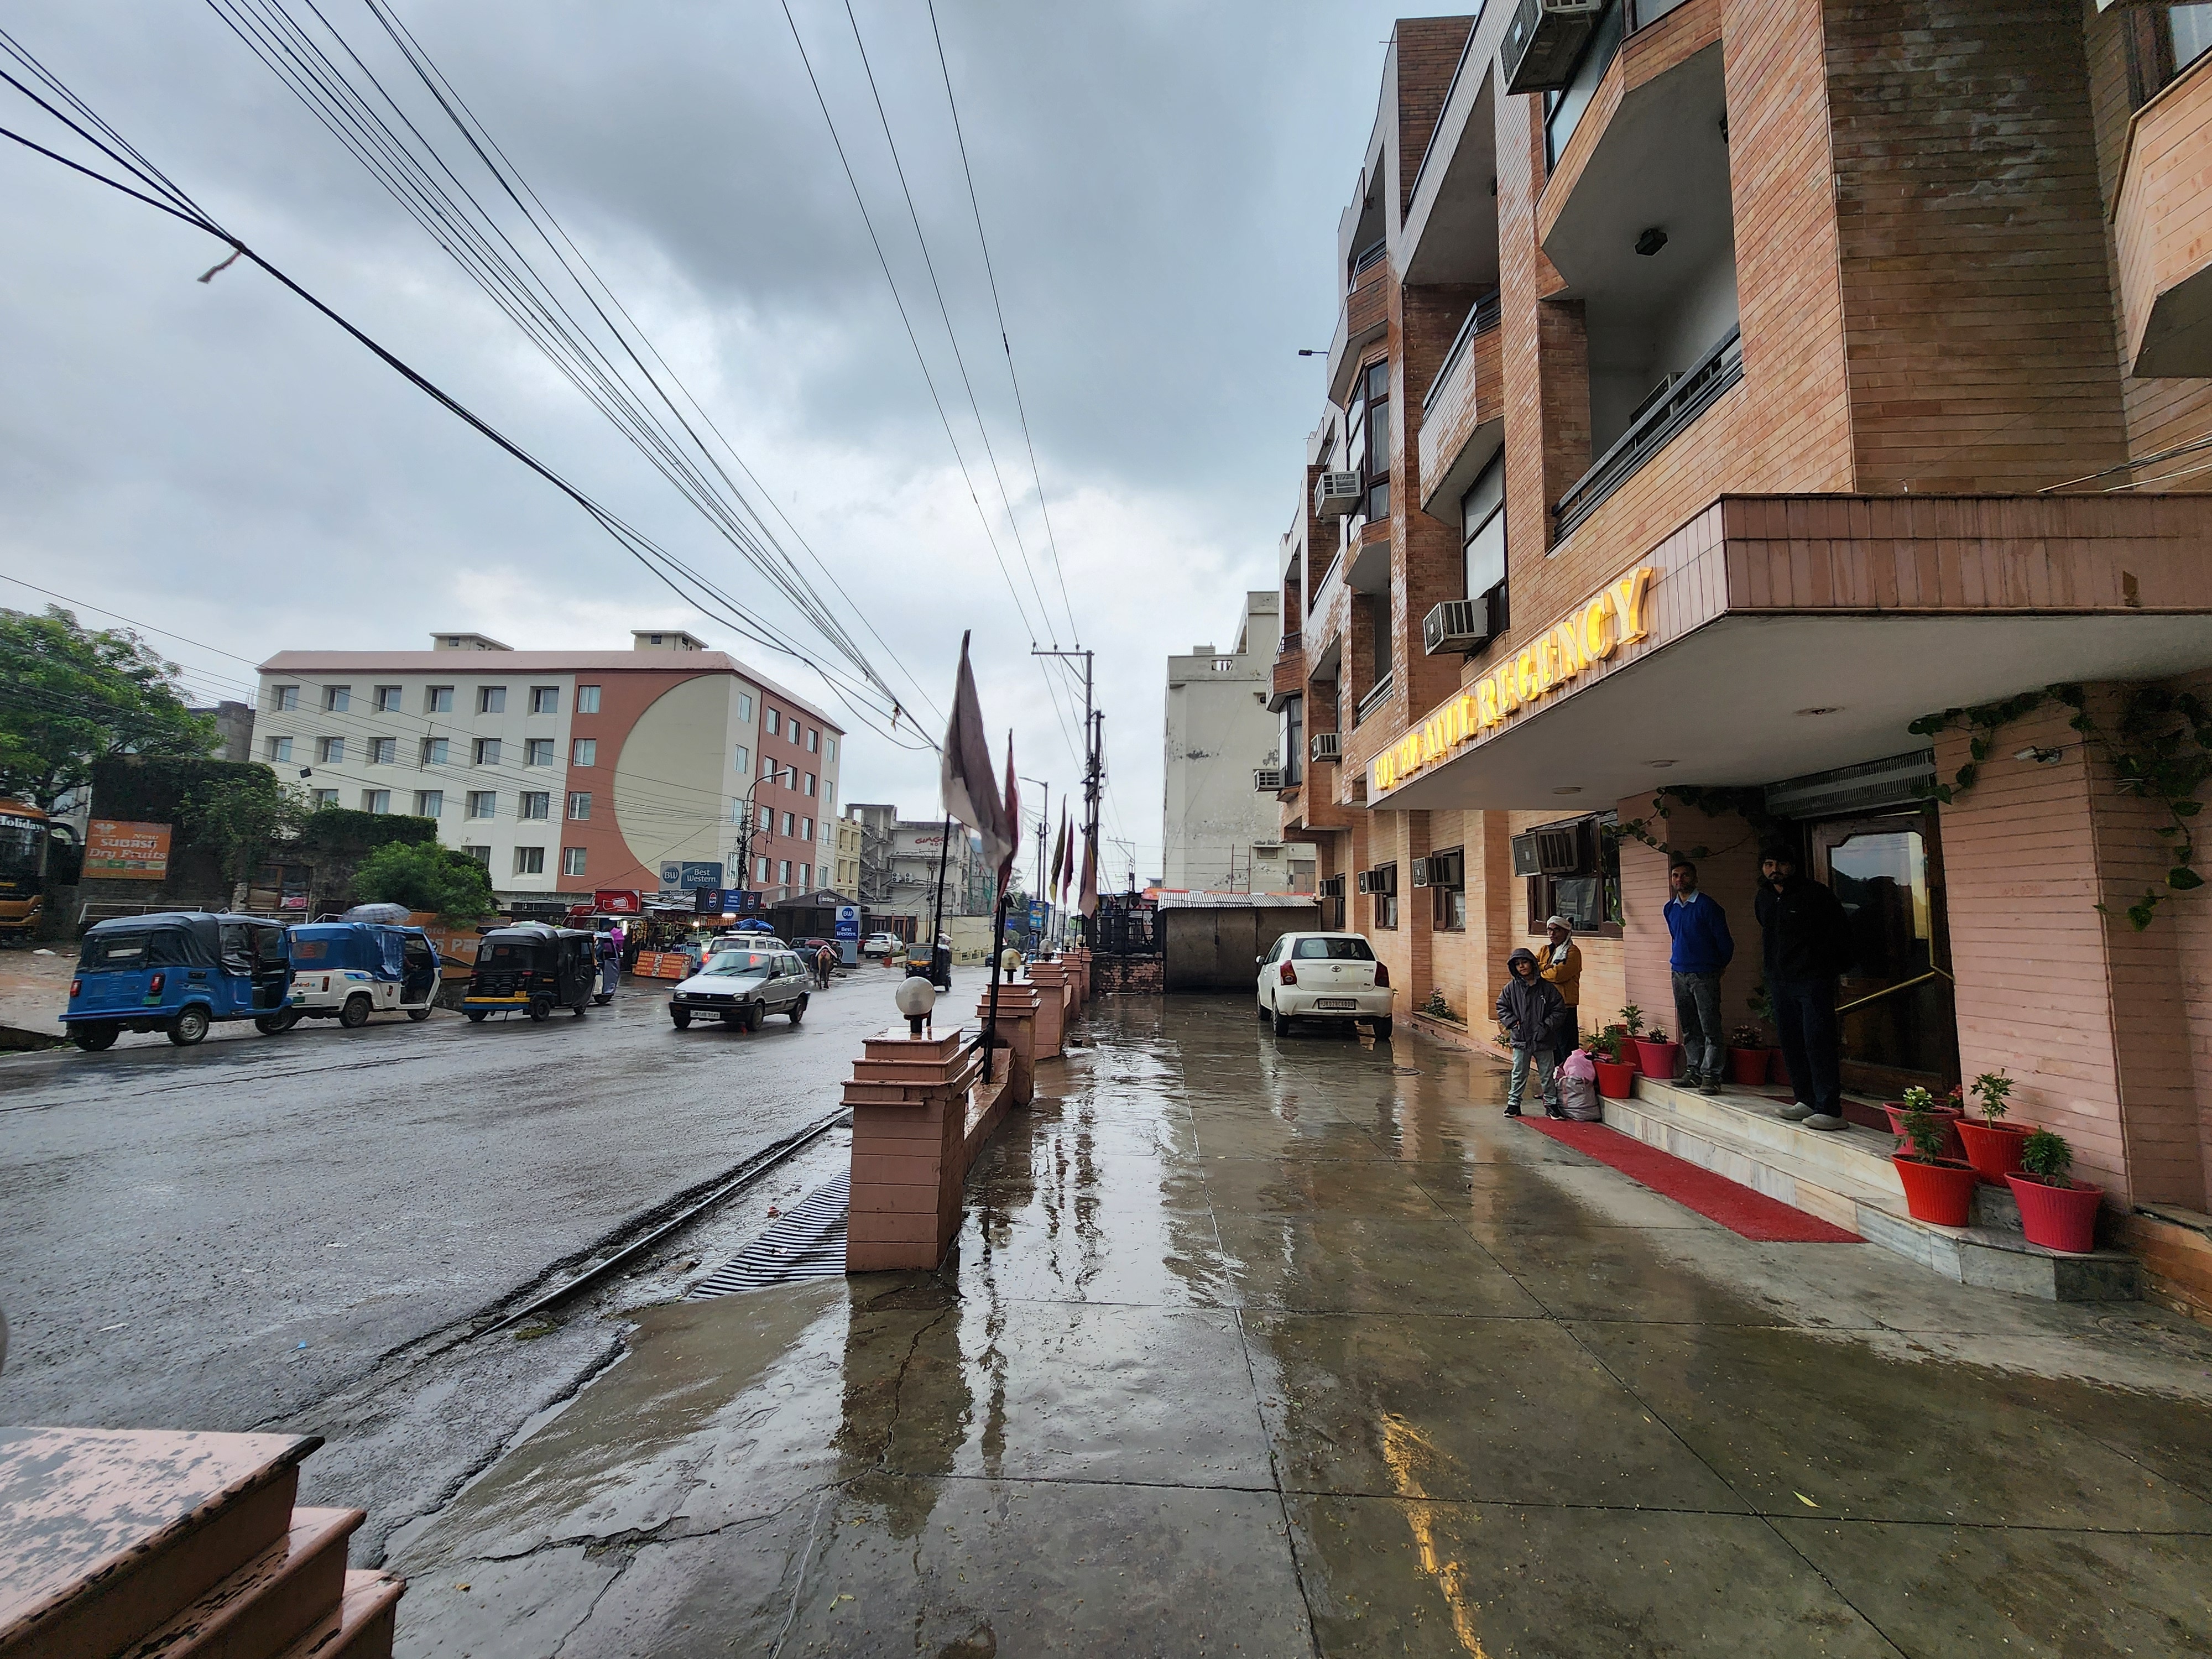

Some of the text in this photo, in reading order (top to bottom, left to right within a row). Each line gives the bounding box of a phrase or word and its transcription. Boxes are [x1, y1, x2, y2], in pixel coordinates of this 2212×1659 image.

[1475, 567, 1653, 728] REGENCY
[88, 848, 166, 859] Dry Fruits
